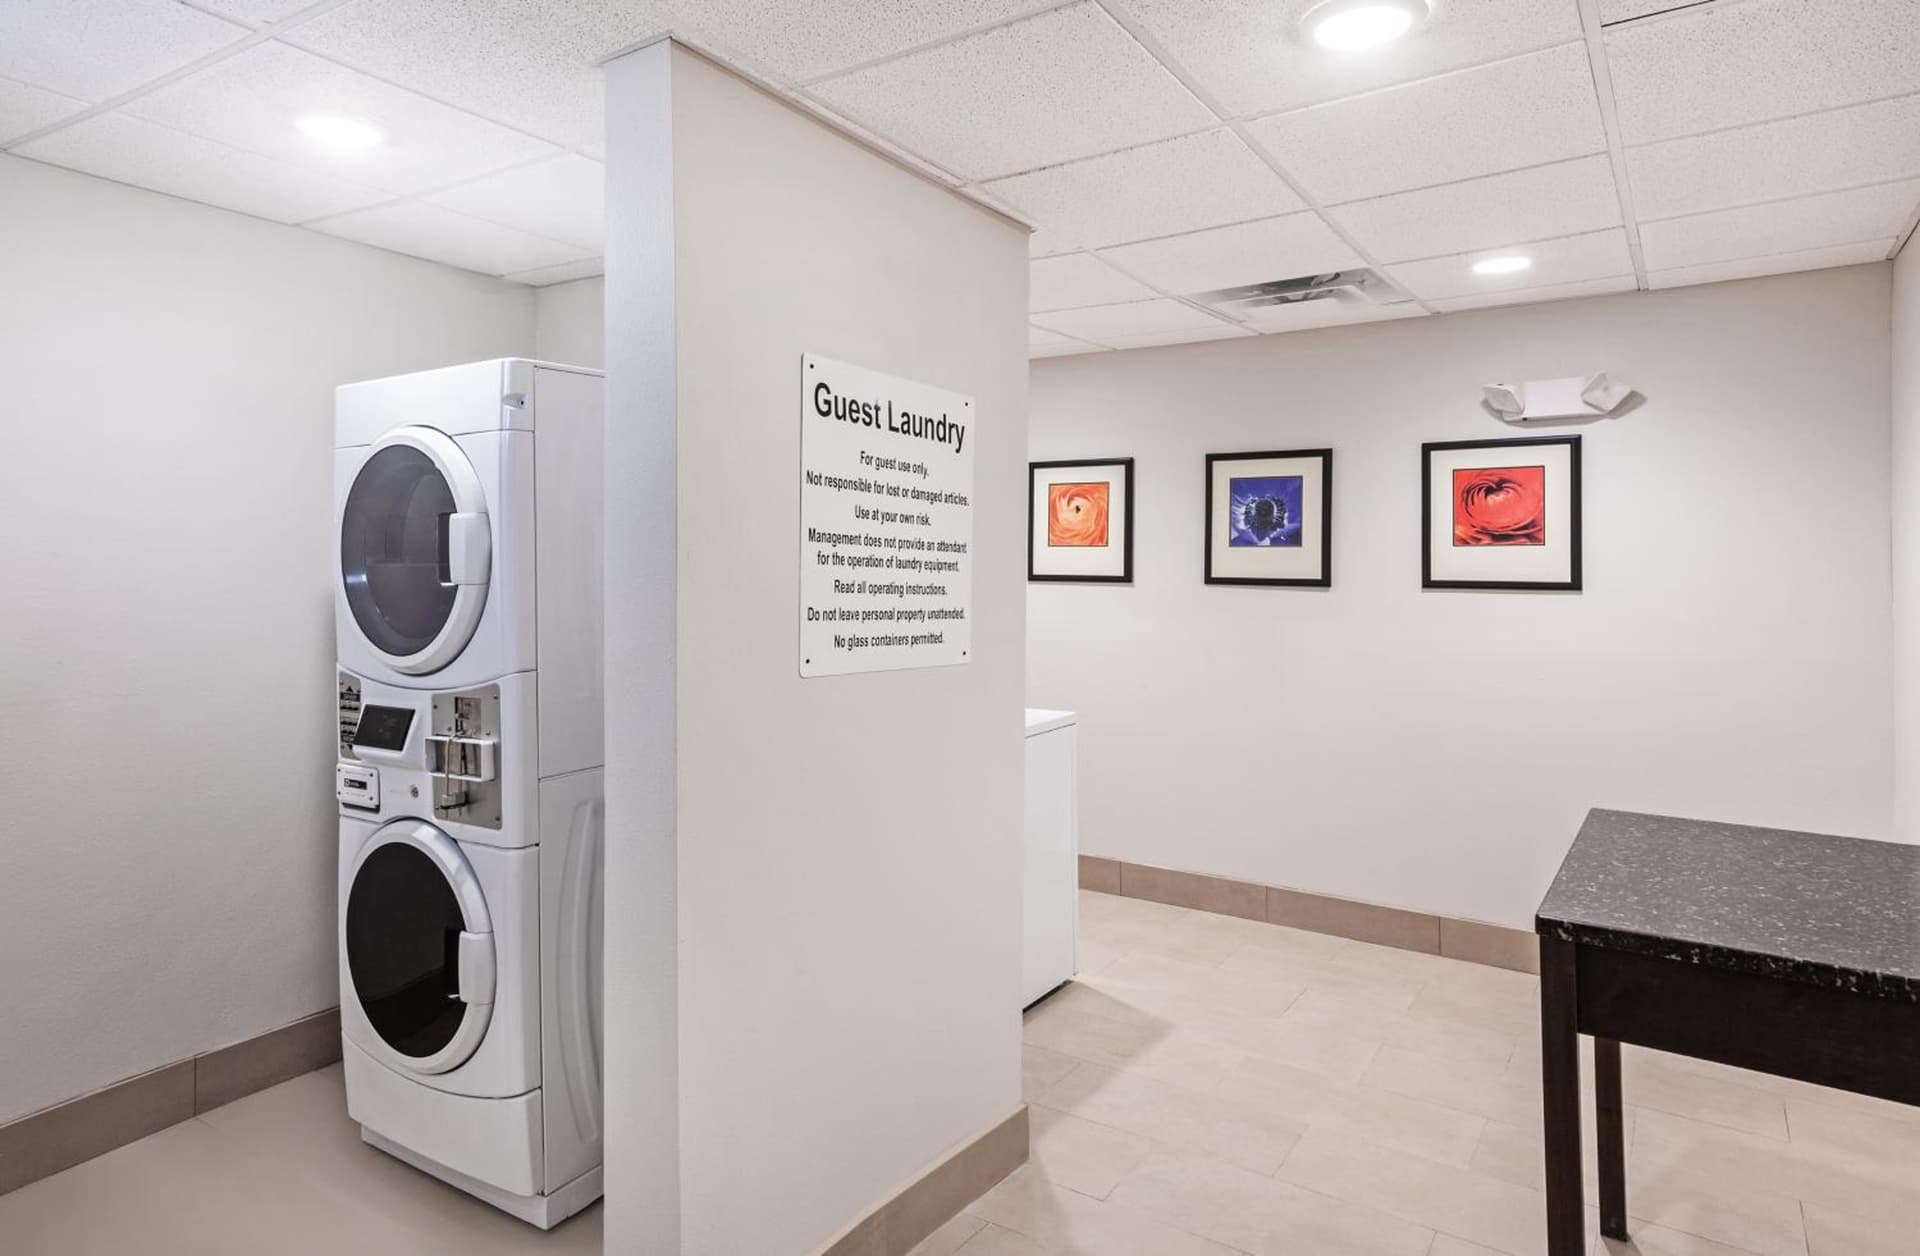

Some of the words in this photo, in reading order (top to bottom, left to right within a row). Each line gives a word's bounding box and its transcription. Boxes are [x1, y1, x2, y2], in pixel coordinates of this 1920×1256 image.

[814, 382, 881, 429] Guest
[888, 400, 965, 454] Laundry
[860, 451, 873, 466] For
[875, 454, 897, 471] guest
[898, 461, 911, 473] use
[912, 462, 929, 479] only.
[806, 470, 822, 486] Not
[824, 474, 872, 493] responsible
[873, 480, 885, 495] for
[886, 482, 900, 497] lost
[901, 487, 909, 498] or
[911, 486, 942, 504] damaged
[944, 491, 969, 506] articles.
[855, 504, 870, 520] Use
[871, 508, 879, 521] at
[881, 510, 898, 525] your
[899, 514, 914, 525] own
[916, 513, 931, 526] risk.
[808, 528, 862, 547] Management
[863, 533, 882, 548] does
[884, 536, 897, 549] not
[898, 538, 925, 552] provide
[926, 541, 935, 551] an
[937, 540, 967, 553] attendant
[817, 551, 830, 565] for
[832, 552, 845, 566] the
[847, 554, 884, 571] operation
[885, 555, 894, 569] of
[895, 556, 922, 573] laundry
[923, 559, 959, 574] equipment.
[834, 579, 855, 594] Read
[857, 581, 866, 594] all
[868, 582, 904, 598] operating
[905, 582, 947, 596] instructions.
[807, 607, 820, 621] Do
[822, 608, 837, 621] not
[838, 608, 859, 621] leave
[862, 608, 895, 623] personal
[896, 609, 925, 623] property
[927, 608, 965, 620] unattended.
[834, 635, 845, 648] No
[847, 634, 869, 651] glass
[871, 633, 909, 647] containers
